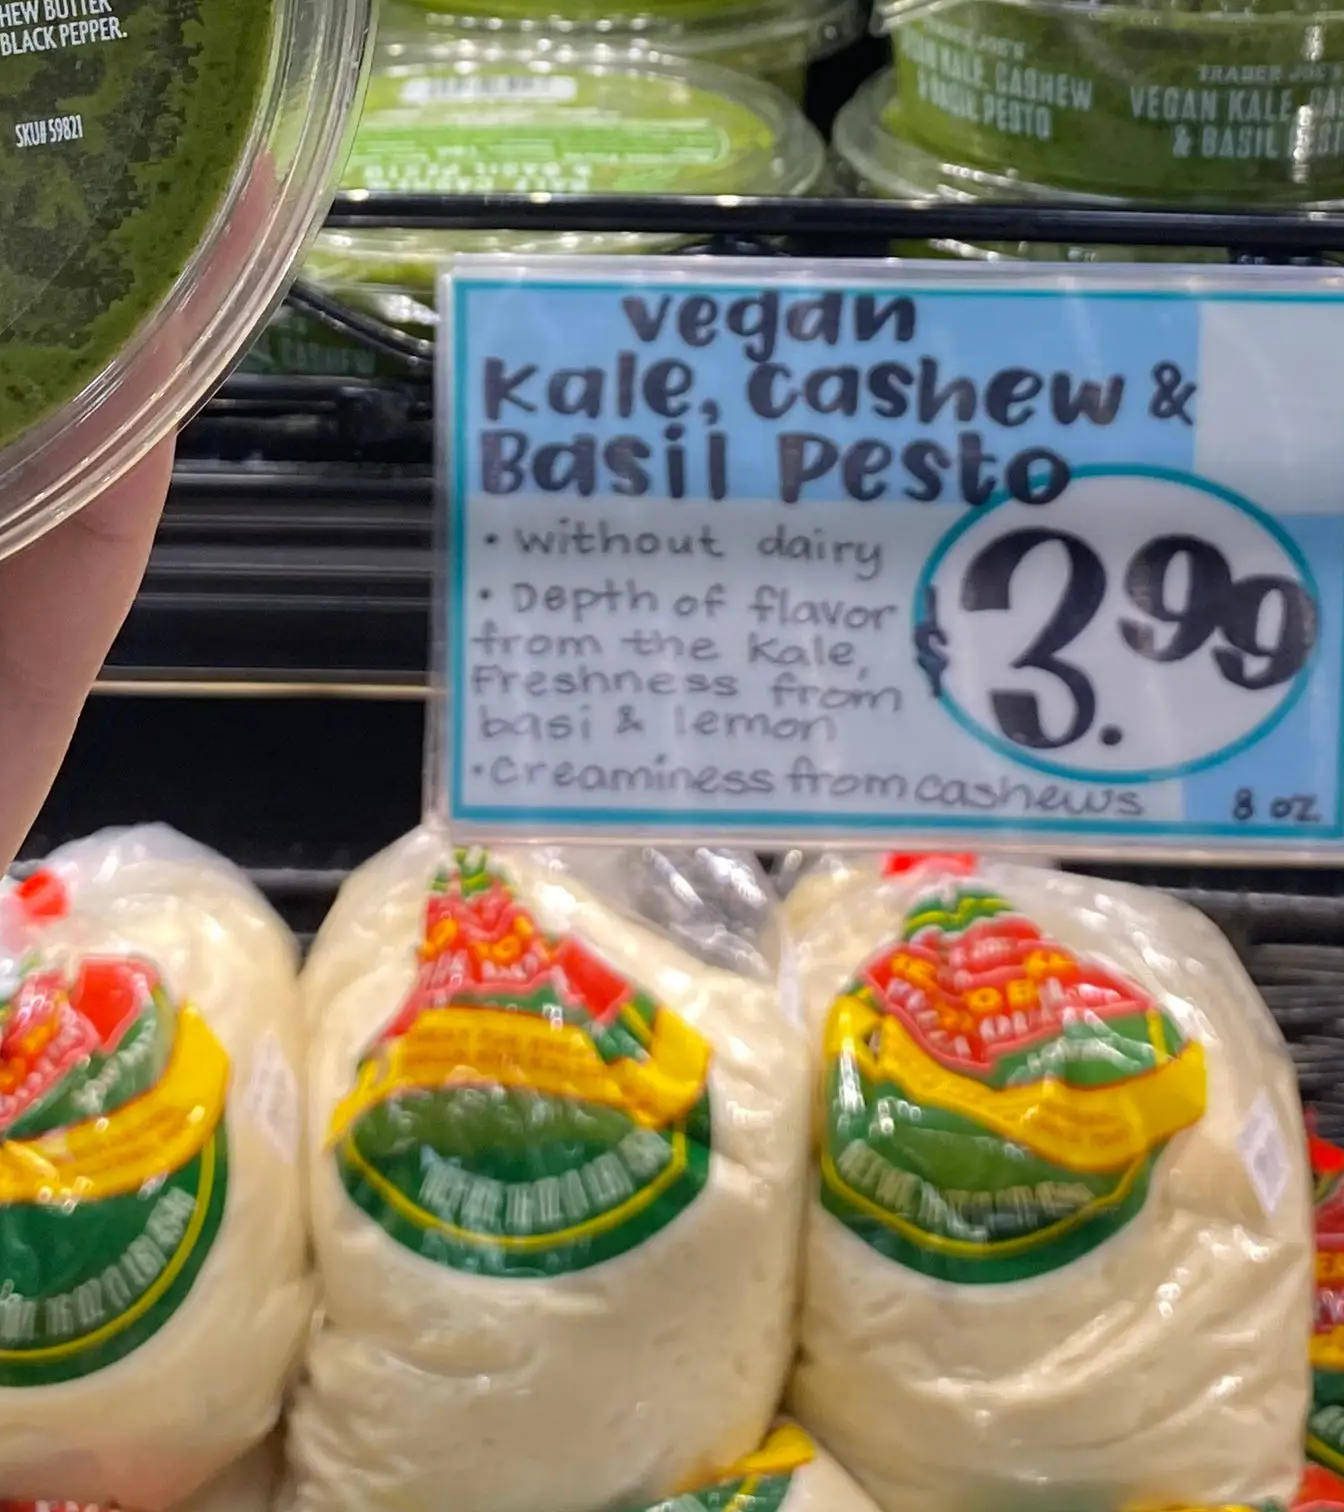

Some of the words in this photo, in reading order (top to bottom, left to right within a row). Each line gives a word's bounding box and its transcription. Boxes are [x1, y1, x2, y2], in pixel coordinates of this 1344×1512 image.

[15, 120, 47, 148] SKU#
[47, 114, 83, 143] 59821
[1149, 363, 1198, 425] &
[480, 425, 728, 503] Basil
[513, 520, 726, 564] without
[758, 522, 884, 577] dairy
[512, 580, 661, 631] Depth
[673, 584, 726, 621] of
[750, 585, 898, 634] flavor
[470, 624, 603, 663] from
[620, 626, 720, 661] the
[771, 673, 903, 716] from
[617, 706, 646, 738] &
[672, 705, 839, 743] lemon
[787, 763, 911, 802] from
[1232, 788, 1253, 823] 8
